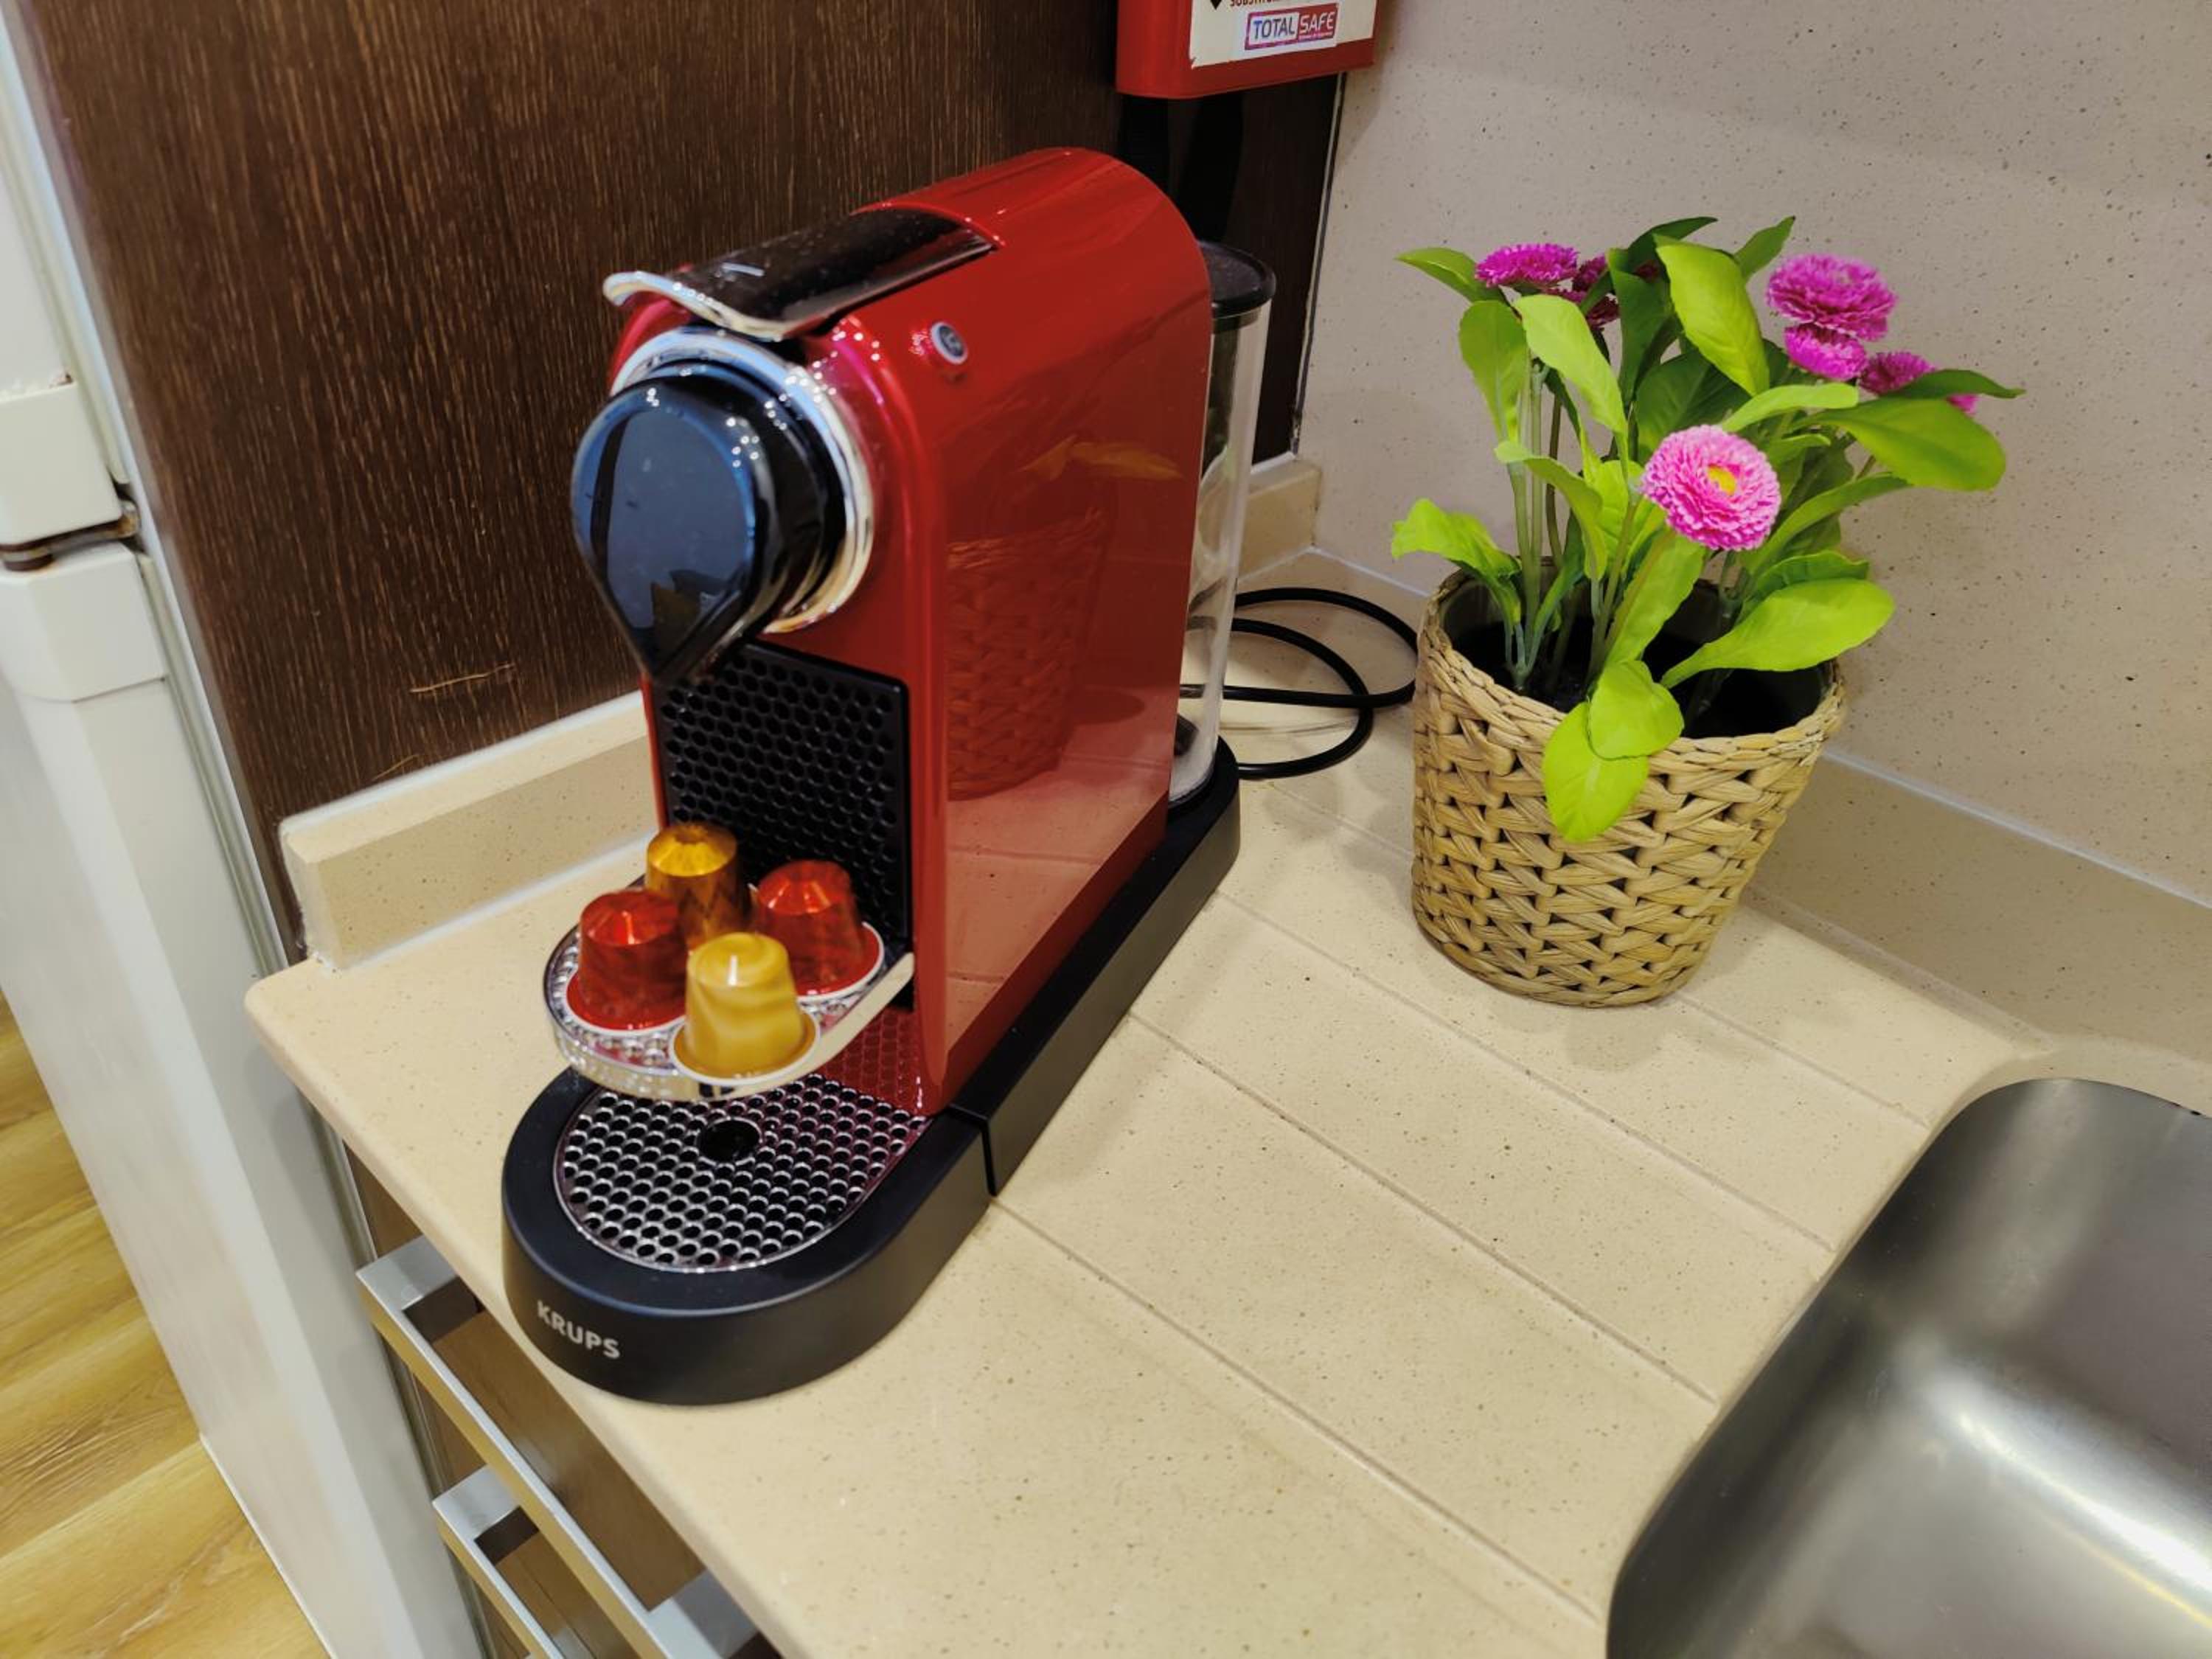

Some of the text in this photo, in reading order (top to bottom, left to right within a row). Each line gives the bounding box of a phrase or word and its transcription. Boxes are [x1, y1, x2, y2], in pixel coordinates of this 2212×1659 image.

[1253, 11, 1335, 39] TOTAL SAFE
[537, 1299, 621, 1359] KRUPS
